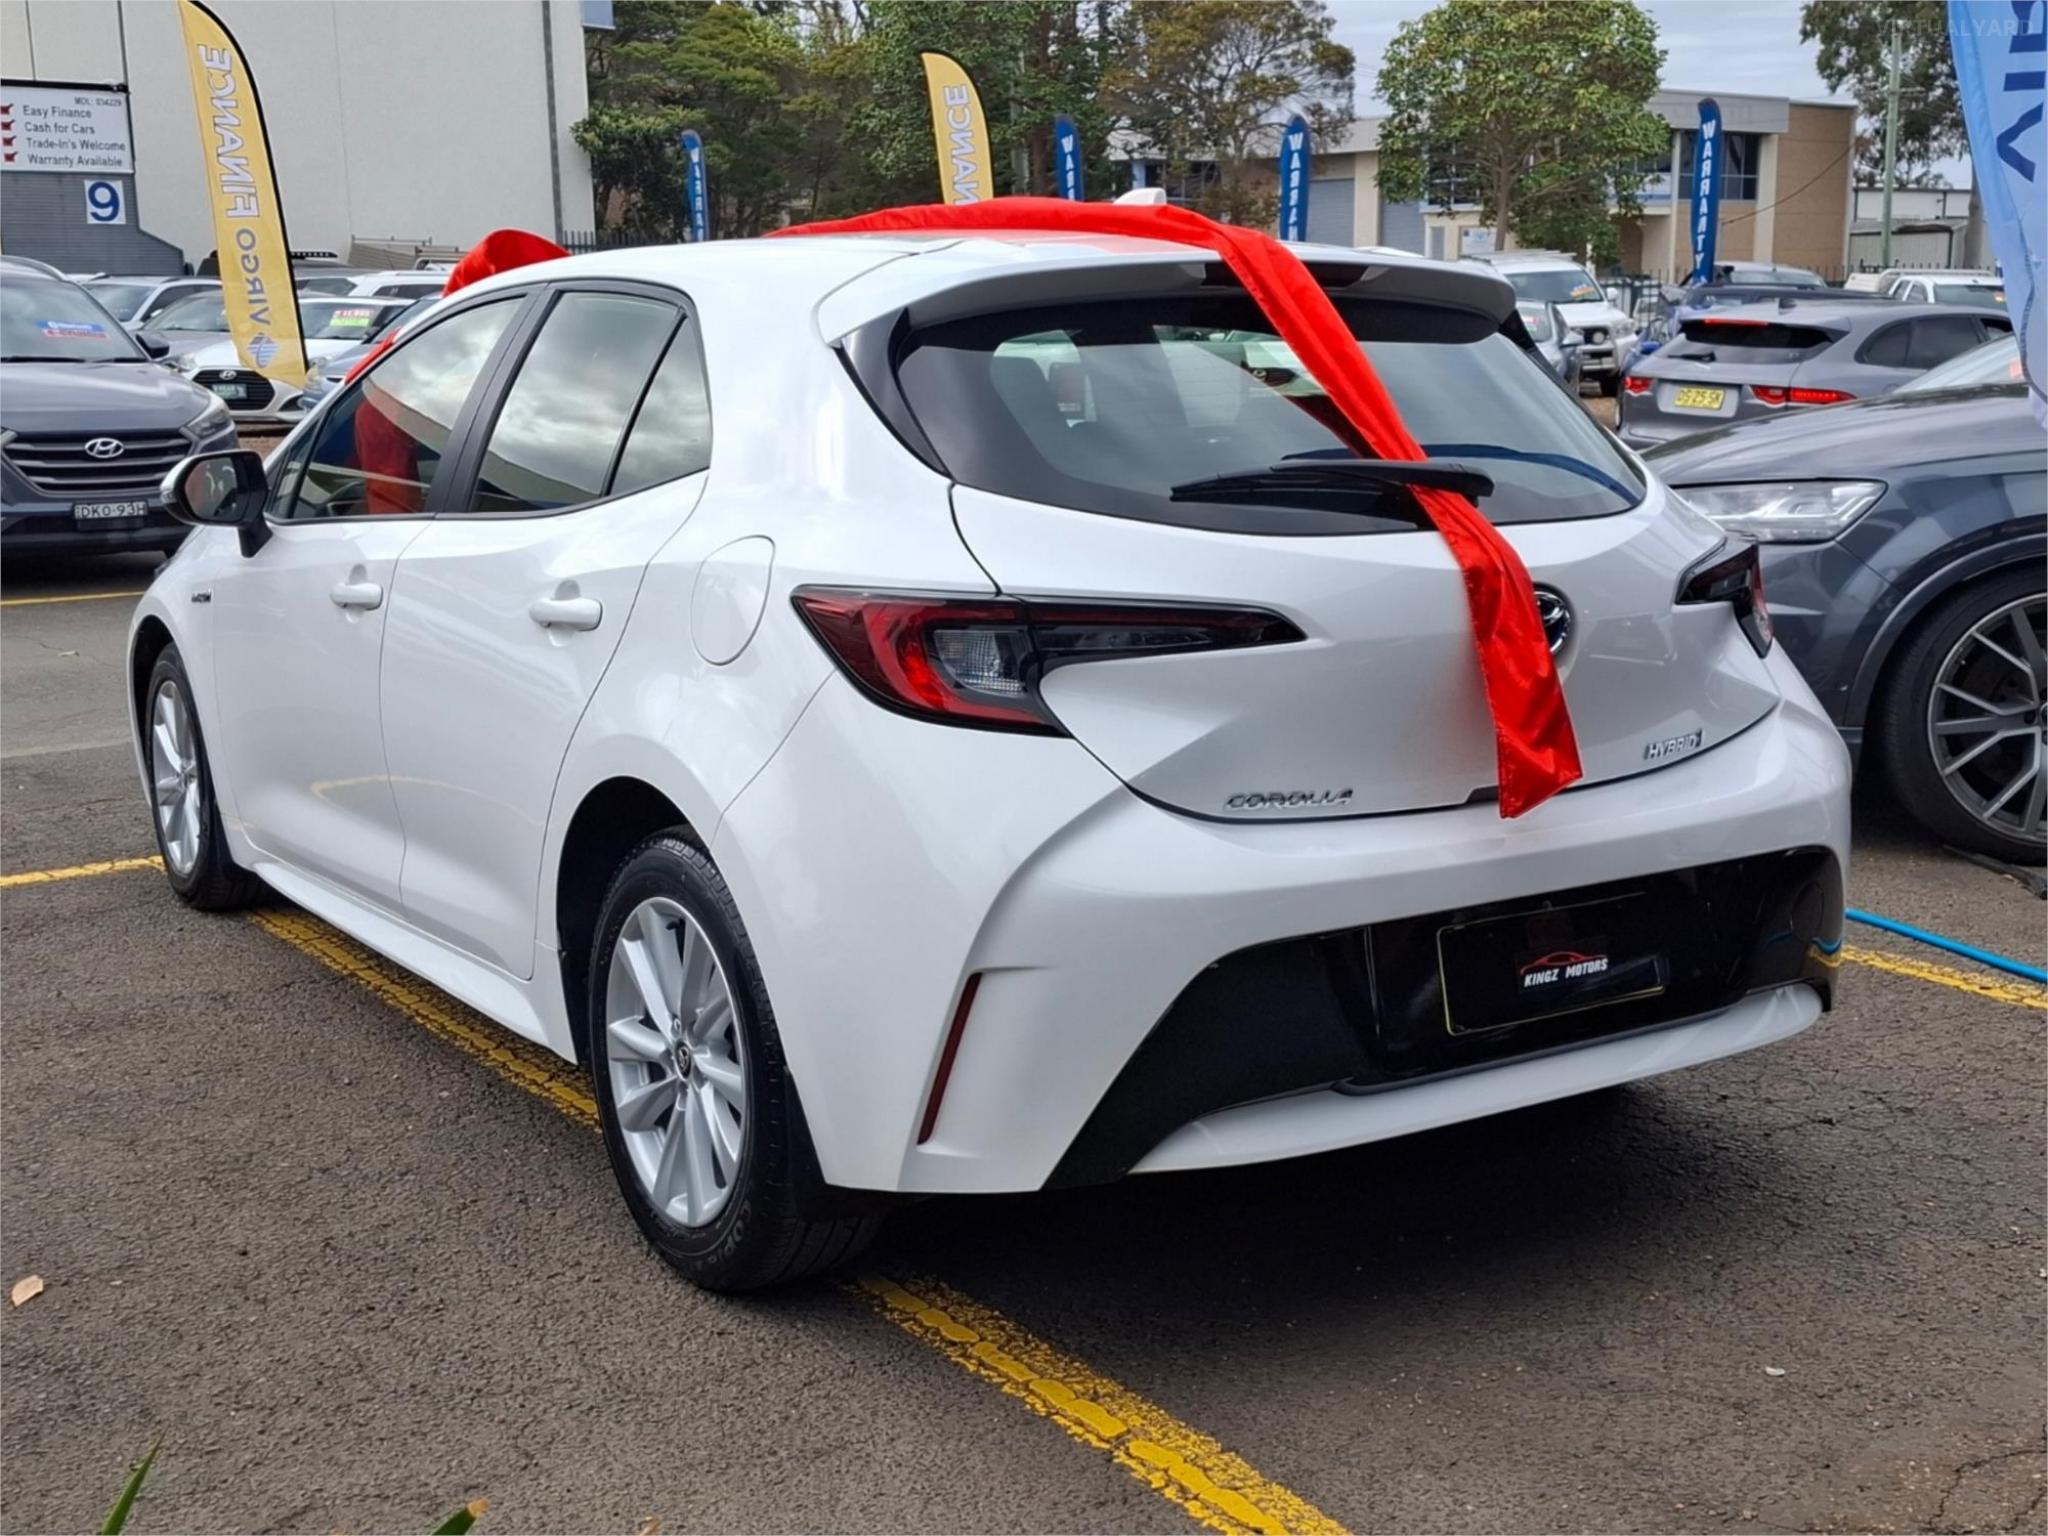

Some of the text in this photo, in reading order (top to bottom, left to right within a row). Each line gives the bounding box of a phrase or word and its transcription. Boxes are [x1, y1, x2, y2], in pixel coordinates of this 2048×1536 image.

[23, 105, 92, 119] Easy Finance
[24, 121, 95, 134] Cash for Cars
[26, 137, 126, 151] Trade-In's Welcome
[27, 154, 123, 168] Warranty Available
[88, 181, 120, 222] 9
[1645, 731, 1702, 759] HYBRID
[1225, 788, 1354, 809] COROLLA
[1523, 958, 1608, 988] KINGZ MOTORS
